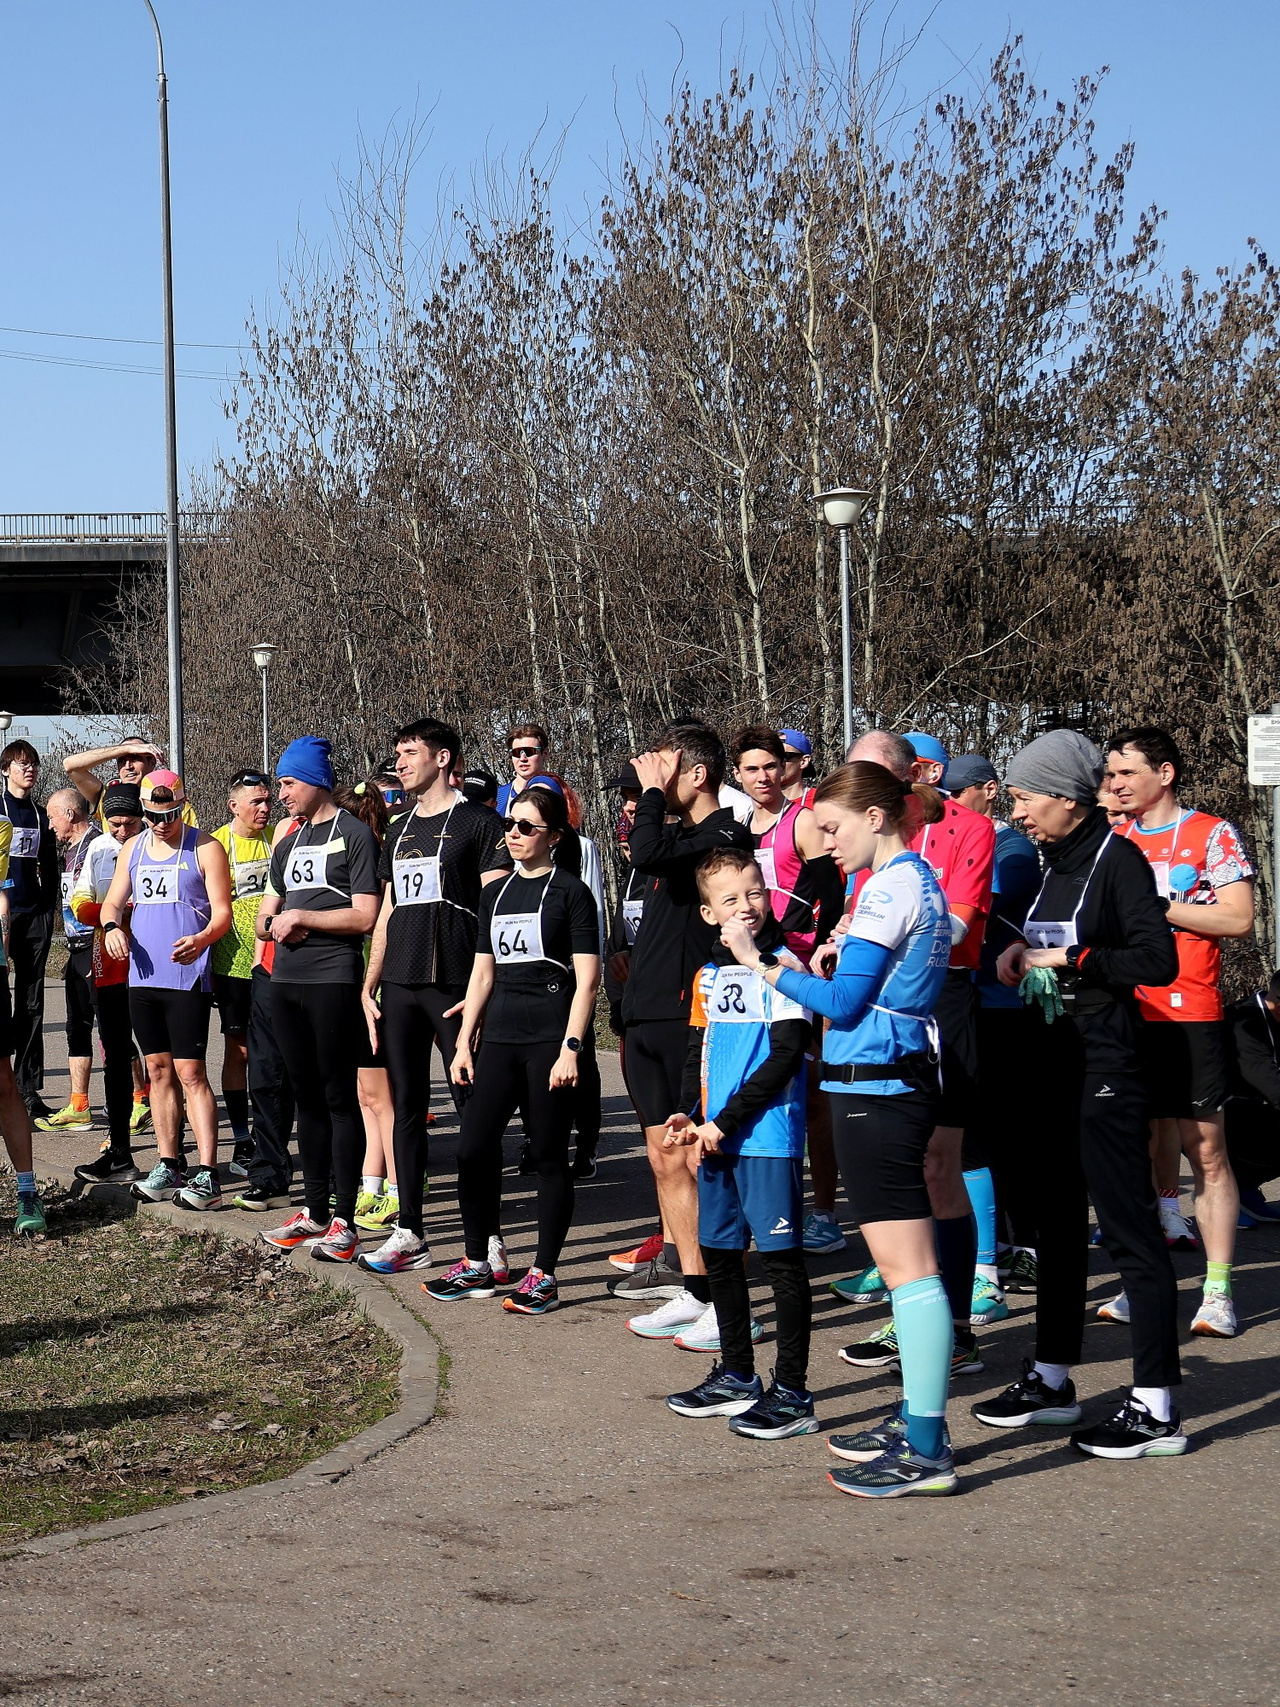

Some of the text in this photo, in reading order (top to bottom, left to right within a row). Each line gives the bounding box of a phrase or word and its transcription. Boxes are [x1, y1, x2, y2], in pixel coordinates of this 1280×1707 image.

[291, 859, 314, 884] 63
[142, 877, 168, 898] 34
[402, 872, 423, 898] 19
[498, 929, 528, 956] 64
